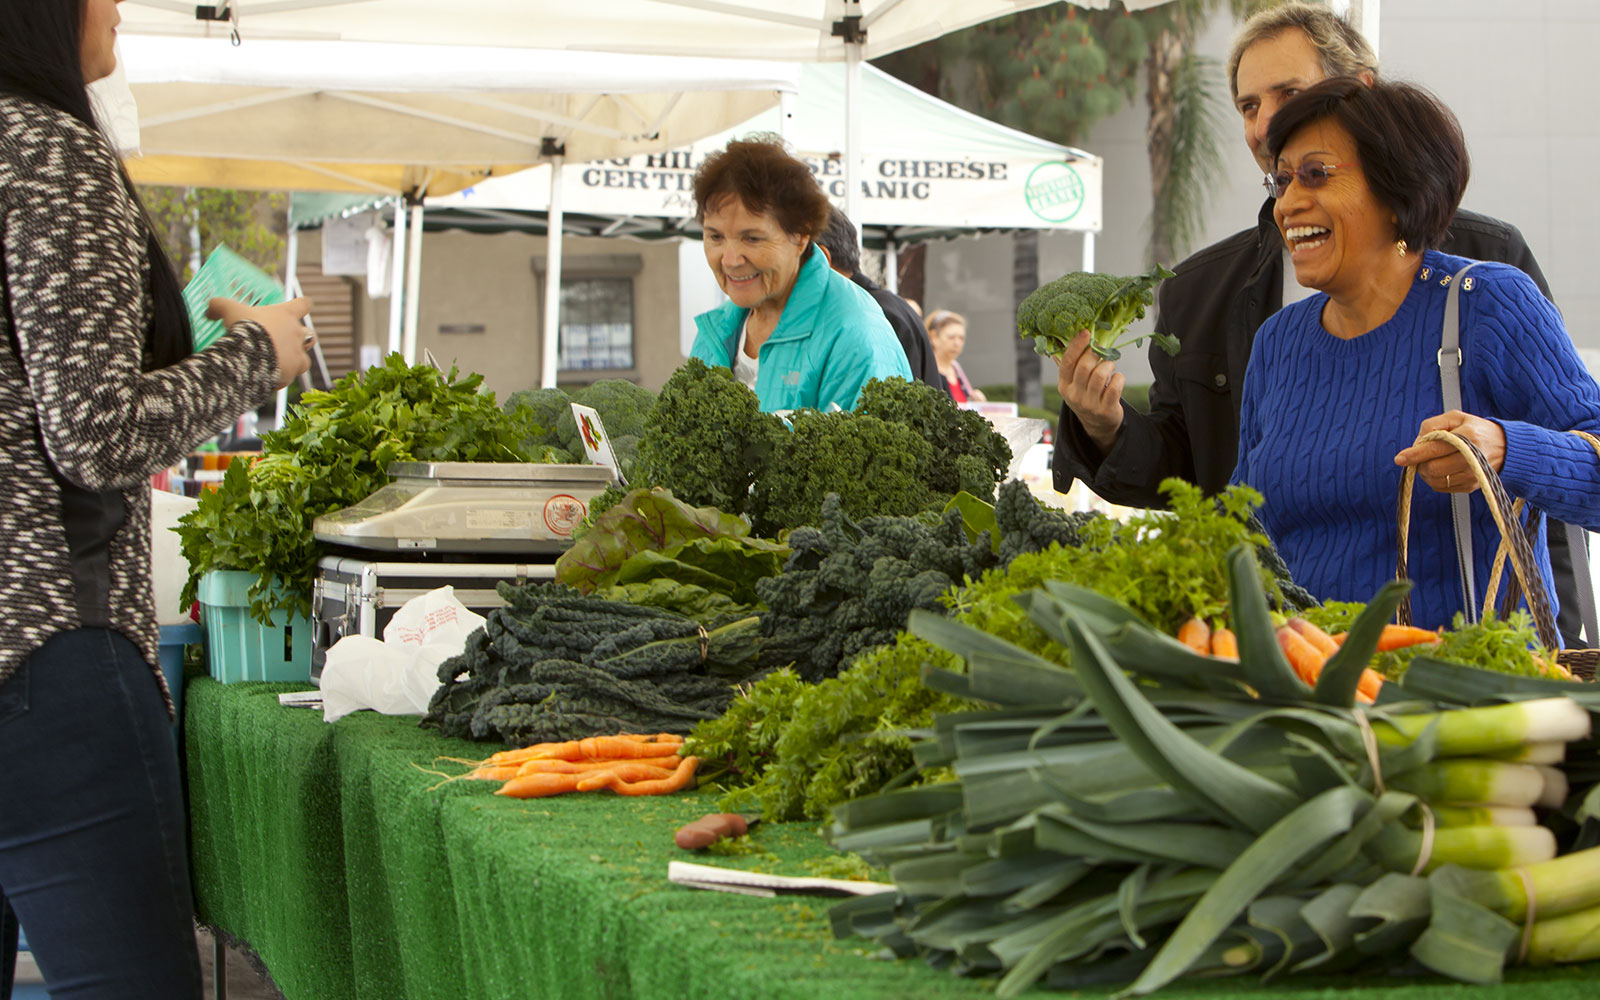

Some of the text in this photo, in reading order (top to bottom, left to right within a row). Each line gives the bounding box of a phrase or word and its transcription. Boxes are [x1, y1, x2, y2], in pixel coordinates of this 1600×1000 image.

[879, 159, 1008, 180] CHEESE
[582, 168, 930, 200] CERTI GANIC
